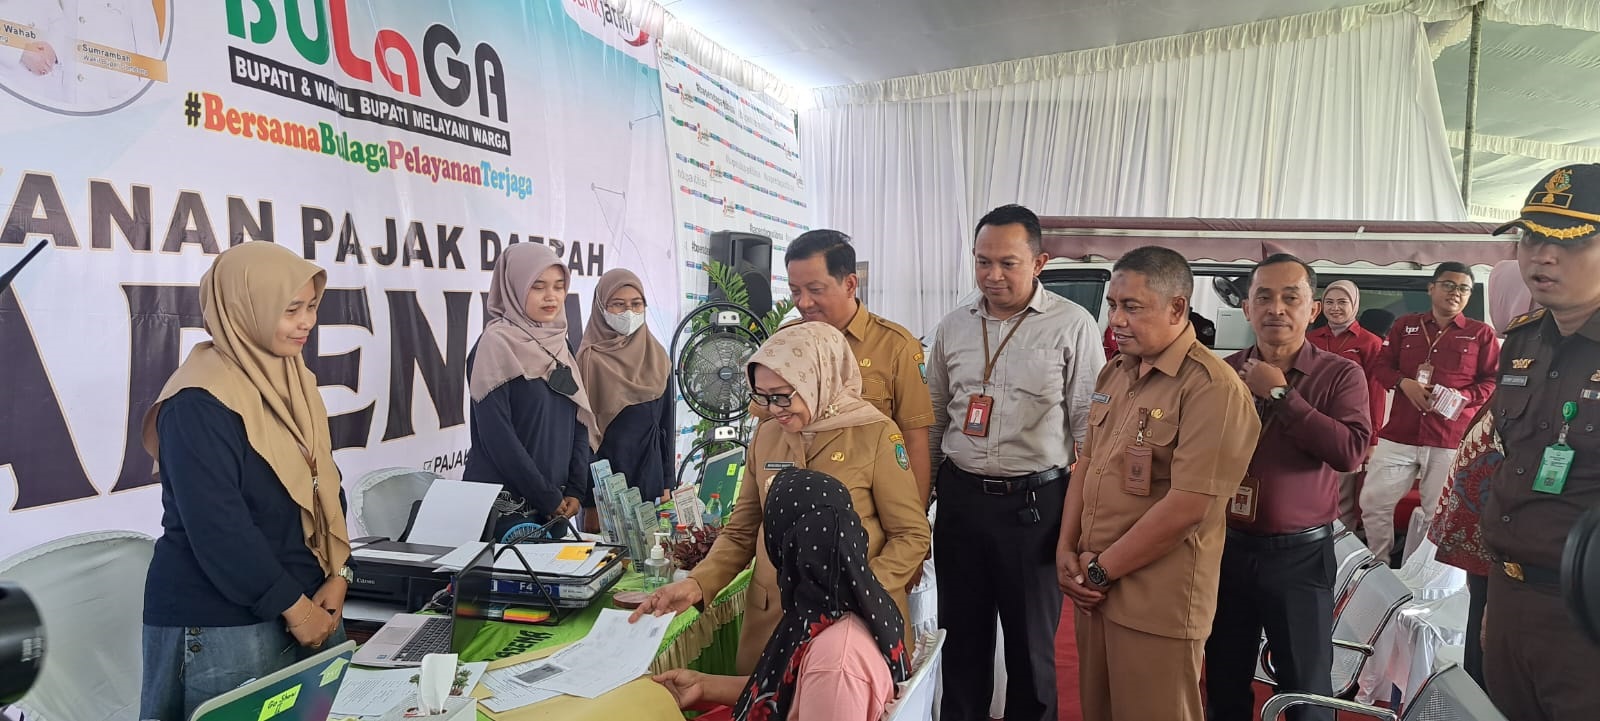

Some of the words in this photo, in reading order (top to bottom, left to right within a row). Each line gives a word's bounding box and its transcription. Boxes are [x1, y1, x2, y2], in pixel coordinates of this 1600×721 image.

[4, 24, 37, 39] Wahab
[82, 43, 131, 62] Sumrambah
[234, 55, 296, 92] BUPATI
[300, 81, 311, 96] &
[360, 98, 409, 126] BUPATI
[413, 109, 469, 141] MELAYANI
[472, 126, 508, 150] WARGA
[0, 170, 275, 254] ANAN
[301, 205, 466, 270] PAJAK
[519, 582, 533, 591] F4
